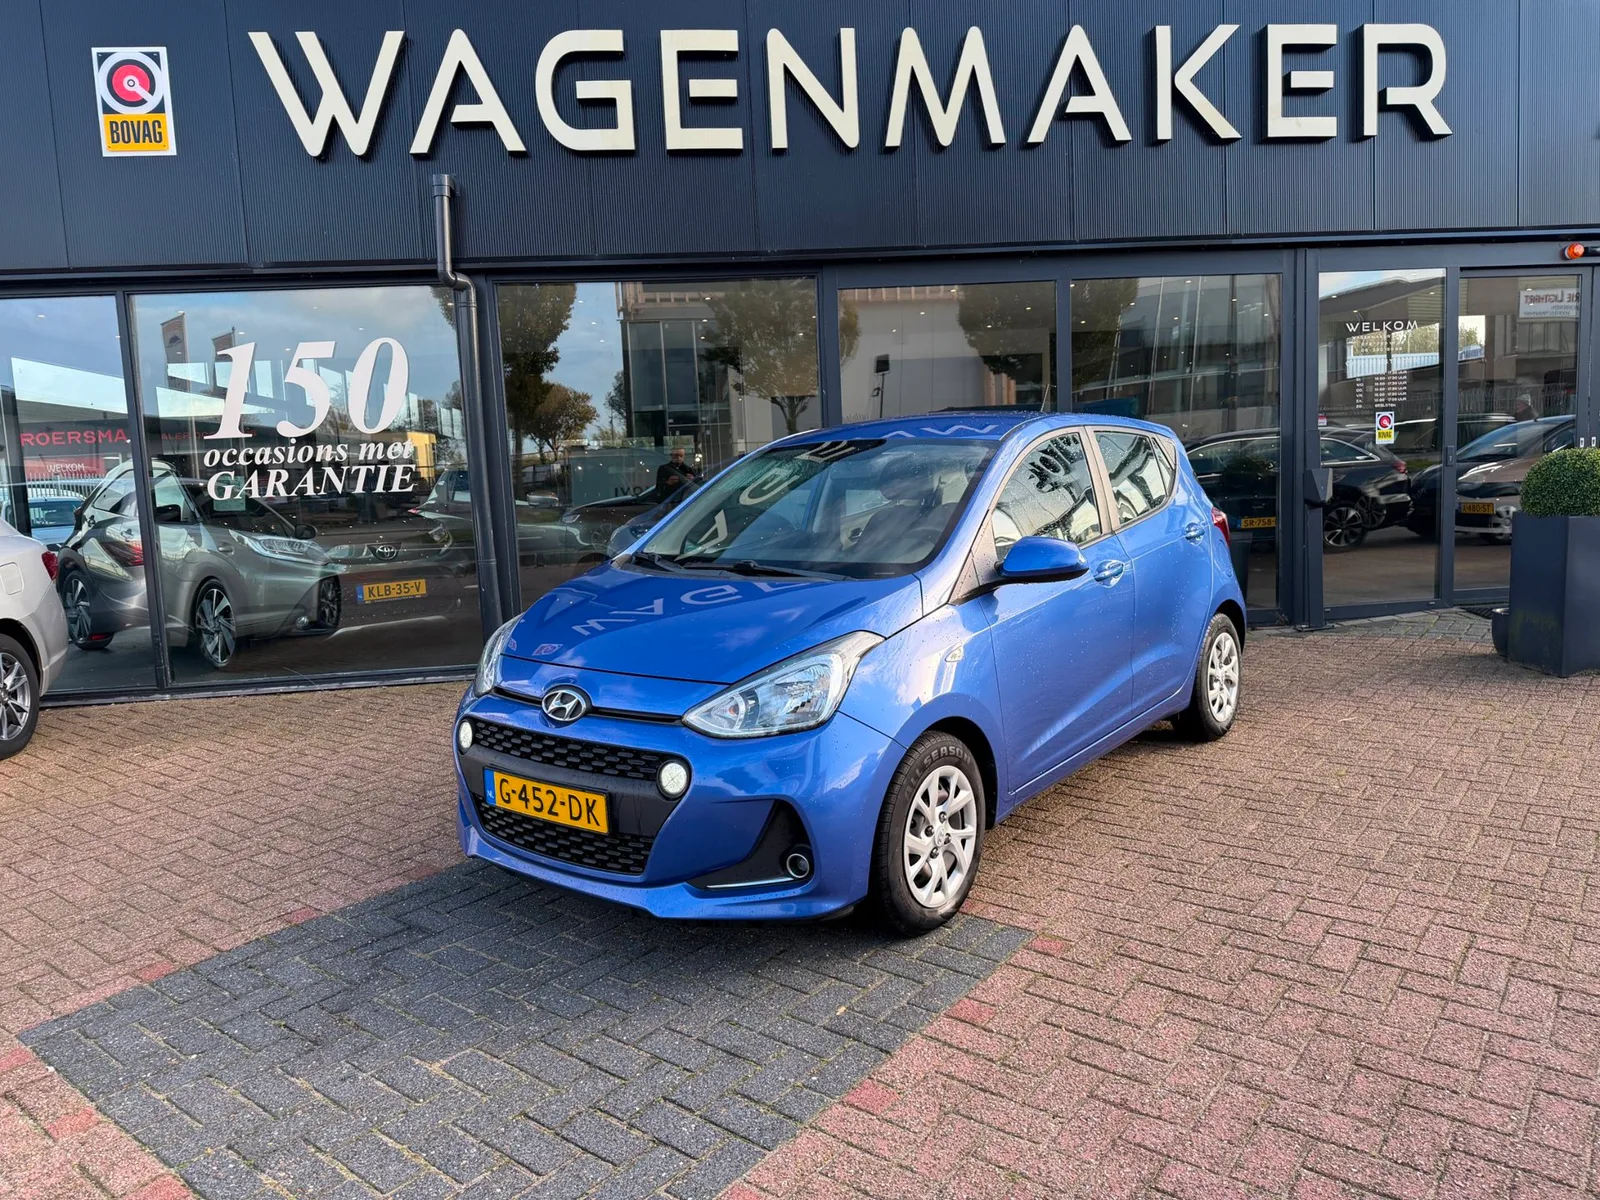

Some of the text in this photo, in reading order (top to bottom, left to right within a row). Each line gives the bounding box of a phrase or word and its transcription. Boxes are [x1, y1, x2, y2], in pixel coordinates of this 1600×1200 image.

[247, 23, 1453, 158] WAGENMAKER
[109, 119, 163, 145] BOVAG
[1346, 320, 1418, 332] WELKOM
[203, 337, 409, 439] 150
[20, 428, 128, 447] ROERSMA
[204, 437, 415, 468] occasions met
[207, 464, 416, 500] GARANTIE
[368, 582, 420, 598] KLB-35-V
[924, 746, 970, 768] SEASON
[500, 778, 600, 827] G-452-DK
